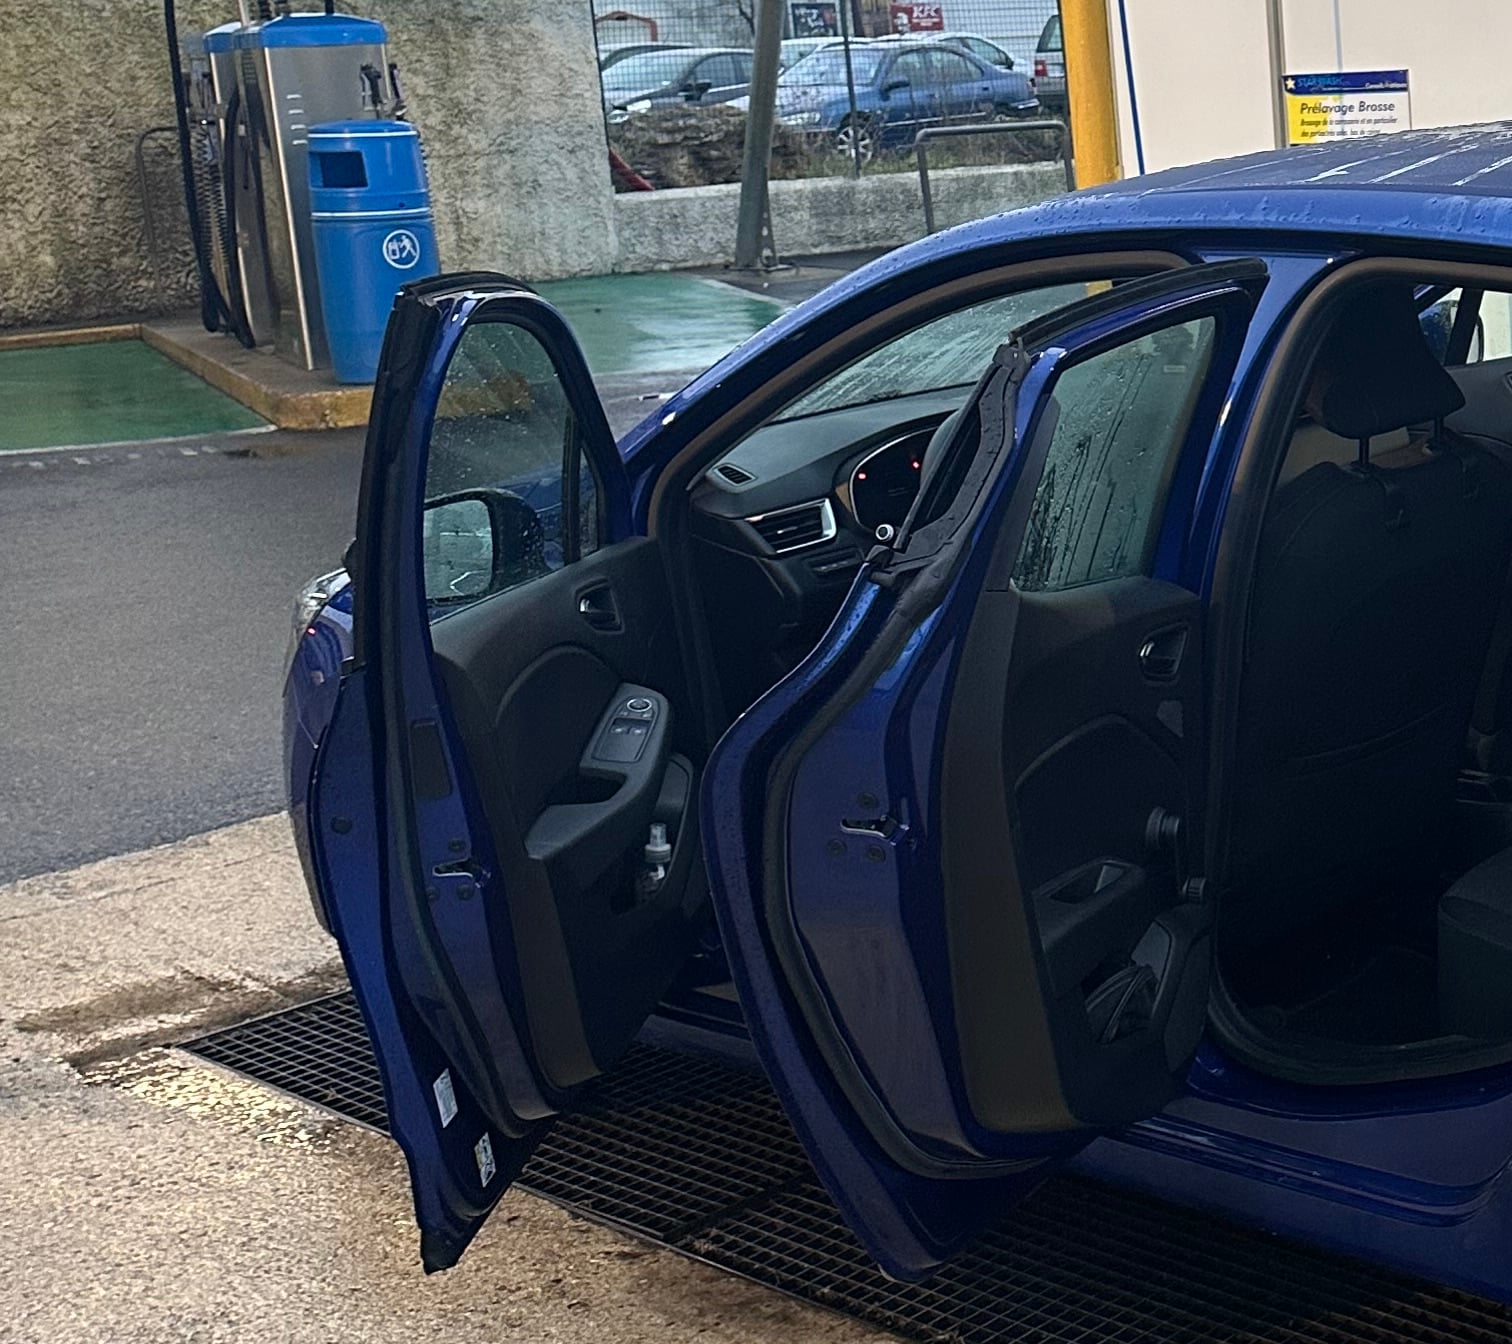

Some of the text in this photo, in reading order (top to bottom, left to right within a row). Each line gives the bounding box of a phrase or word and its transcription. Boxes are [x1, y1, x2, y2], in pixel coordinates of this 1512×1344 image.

[912, 5, 939, 18] KFC
[1300, 100, 1396, 116] Prélavage Brosse
